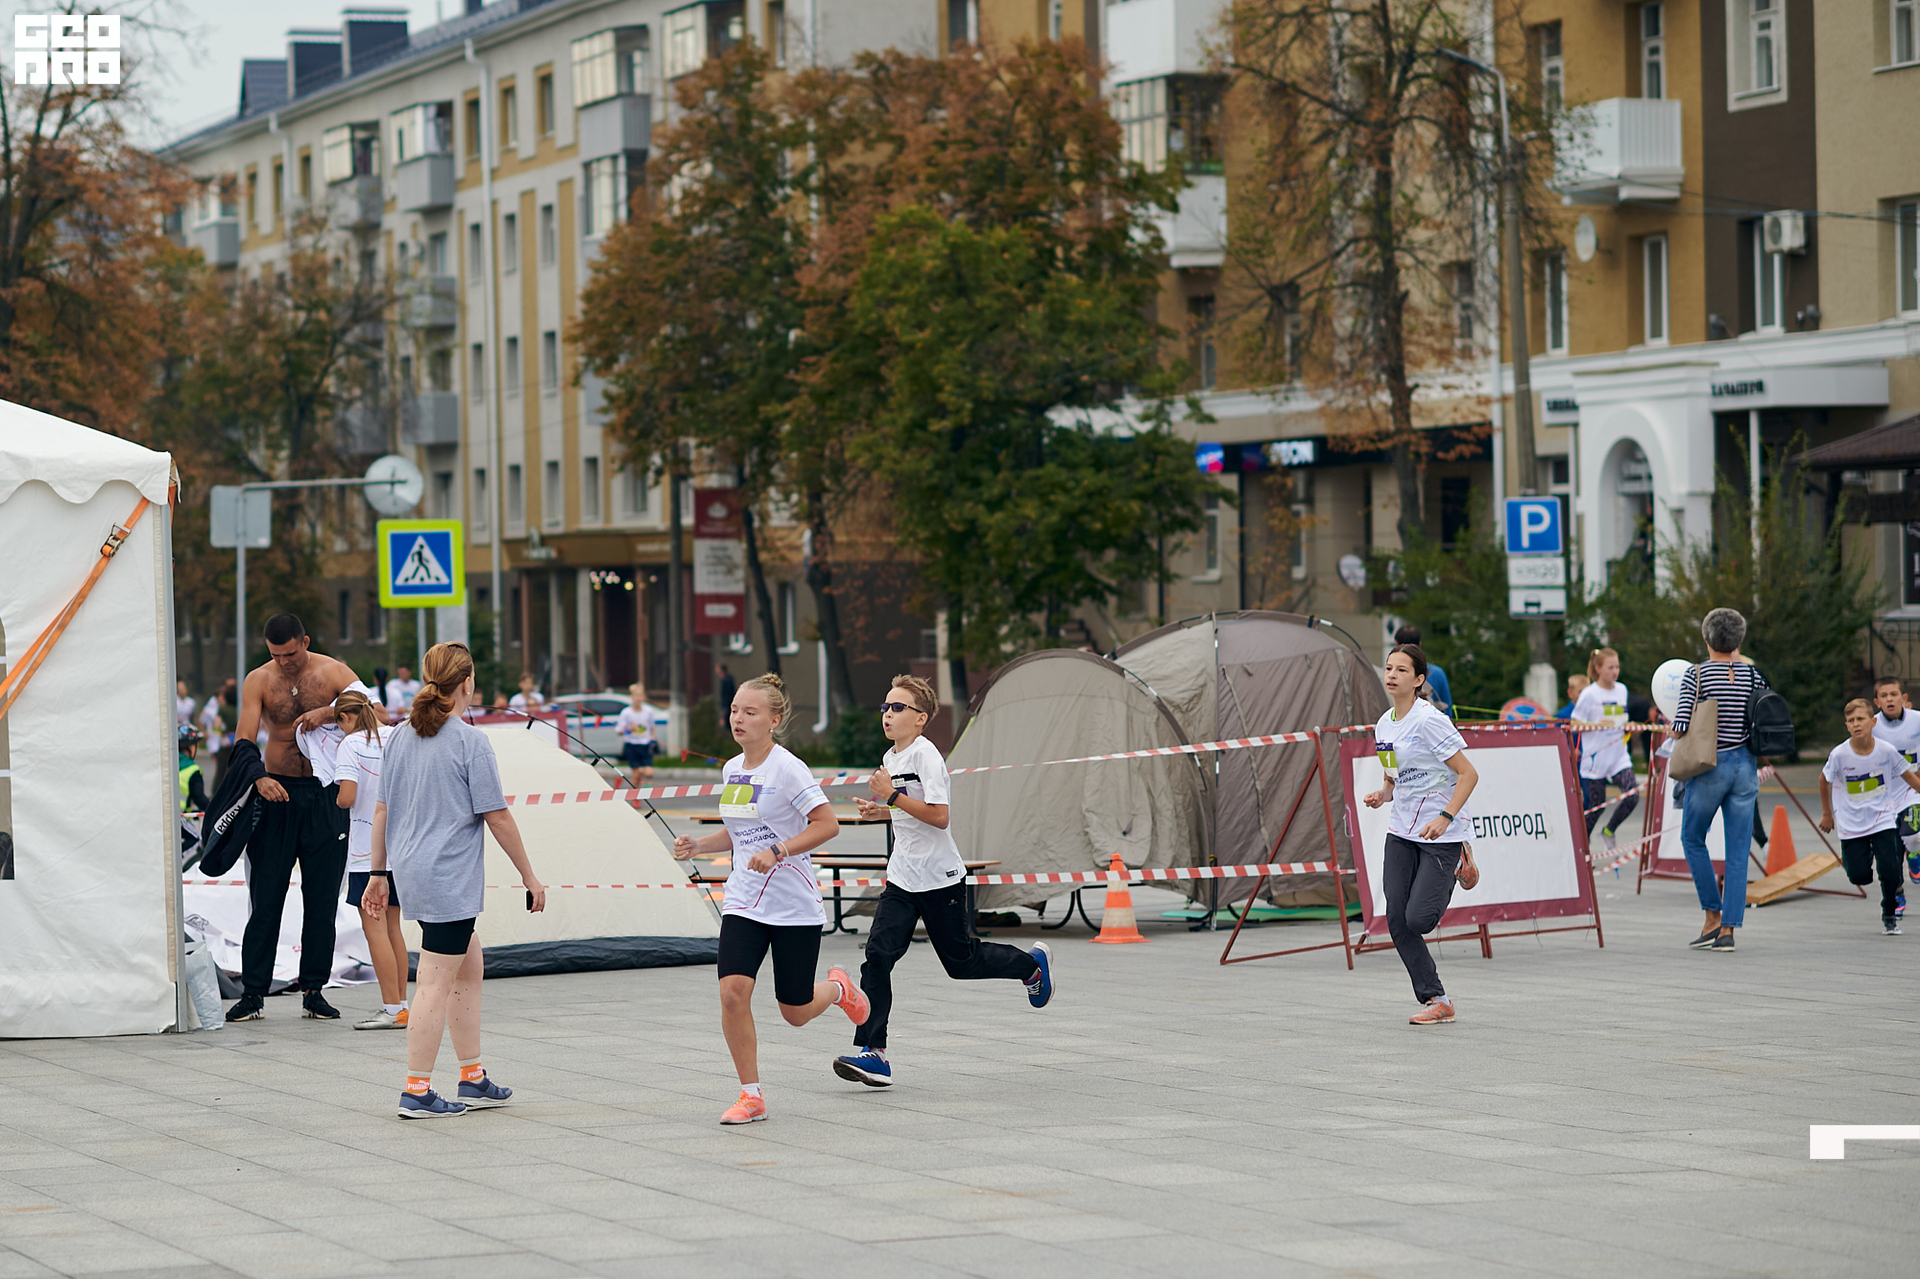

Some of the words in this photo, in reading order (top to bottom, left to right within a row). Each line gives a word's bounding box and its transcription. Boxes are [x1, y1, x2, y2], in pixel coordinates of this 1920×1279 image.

[1520, 504, 1551, 548] P
[1386, 752, 1391, 767] 1
[733, 785, 742, 804] 1
[1859, 781, 1865, 792] 1
